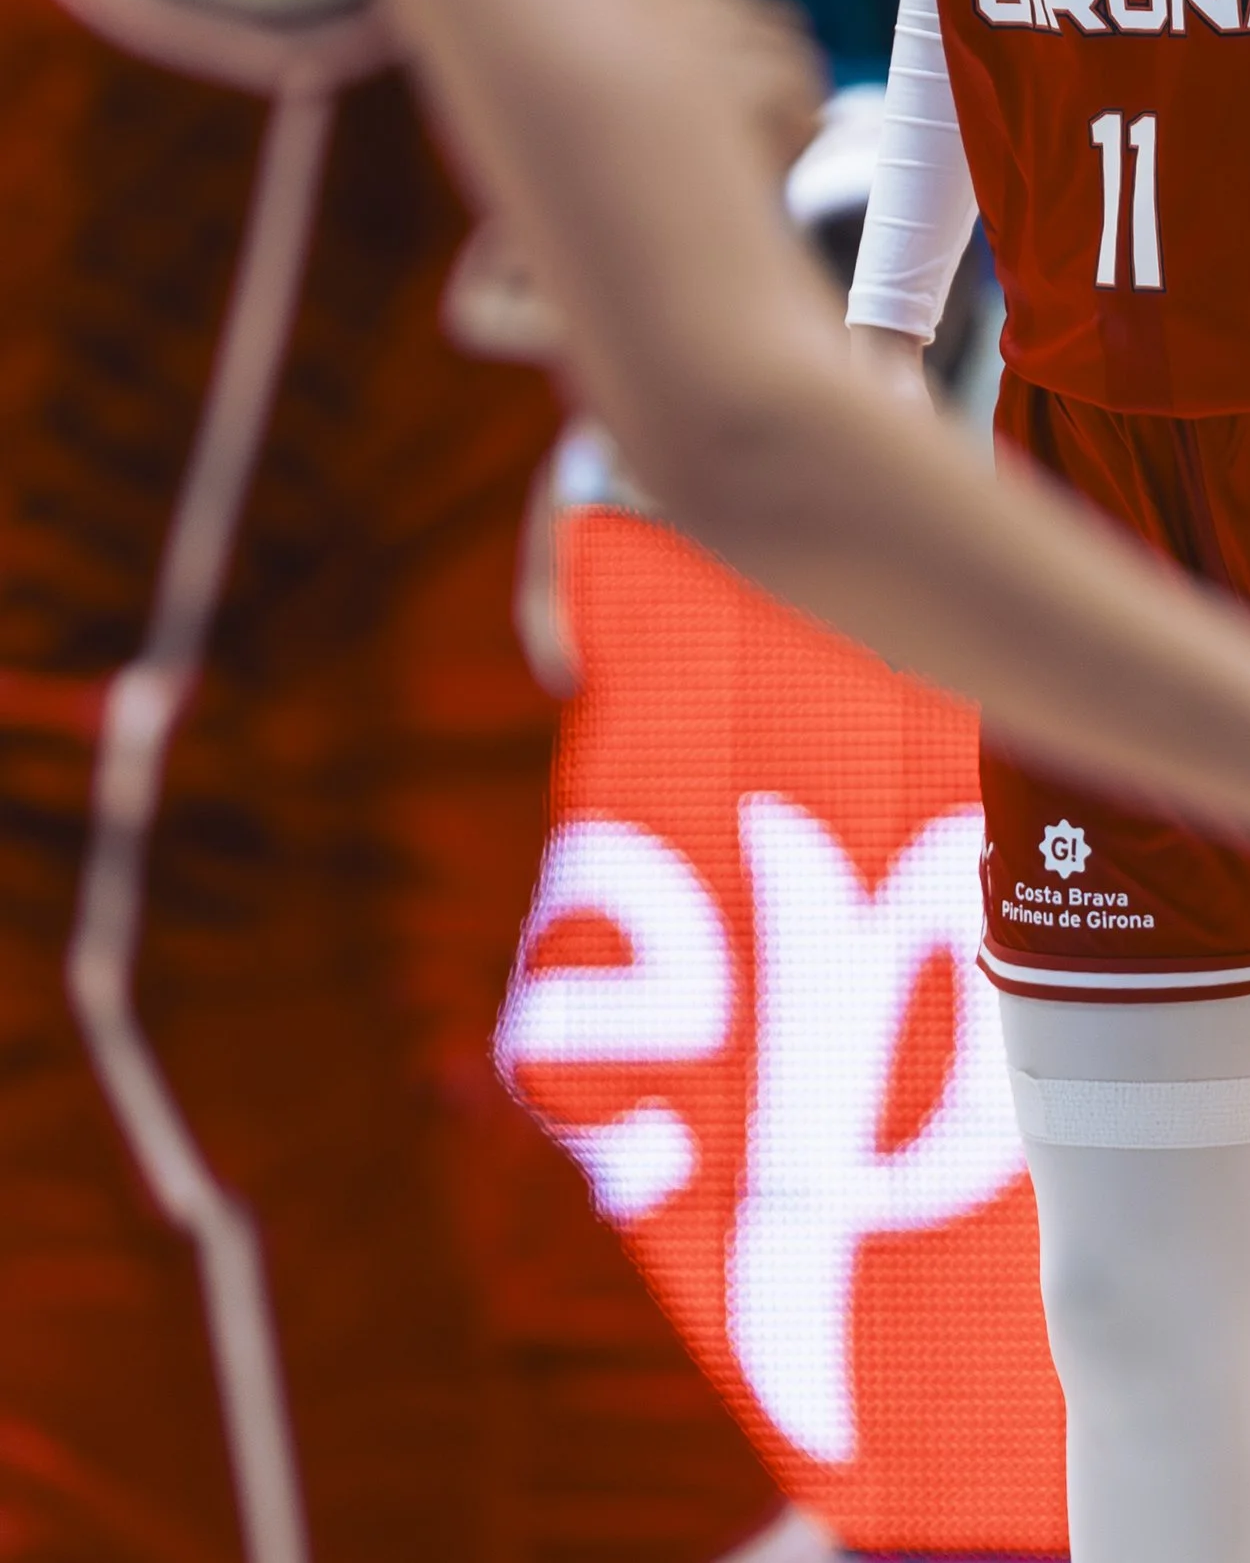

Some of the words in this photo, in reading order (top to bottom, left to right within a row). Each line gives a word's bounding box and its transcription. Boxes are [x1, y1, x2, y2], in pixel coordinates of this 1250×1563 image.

[1088, 108, 1167, 293] 11
[1051, 836, 1077, 862] G!
[1015, 881, 1062, 905] Costa
[1068, 888, 1128, 907] Brava
[1002, 900, 1053, 926] Pirineu
[1058, 910, 1081, 928] de
[1086, 911, 1155, 929] Girona
